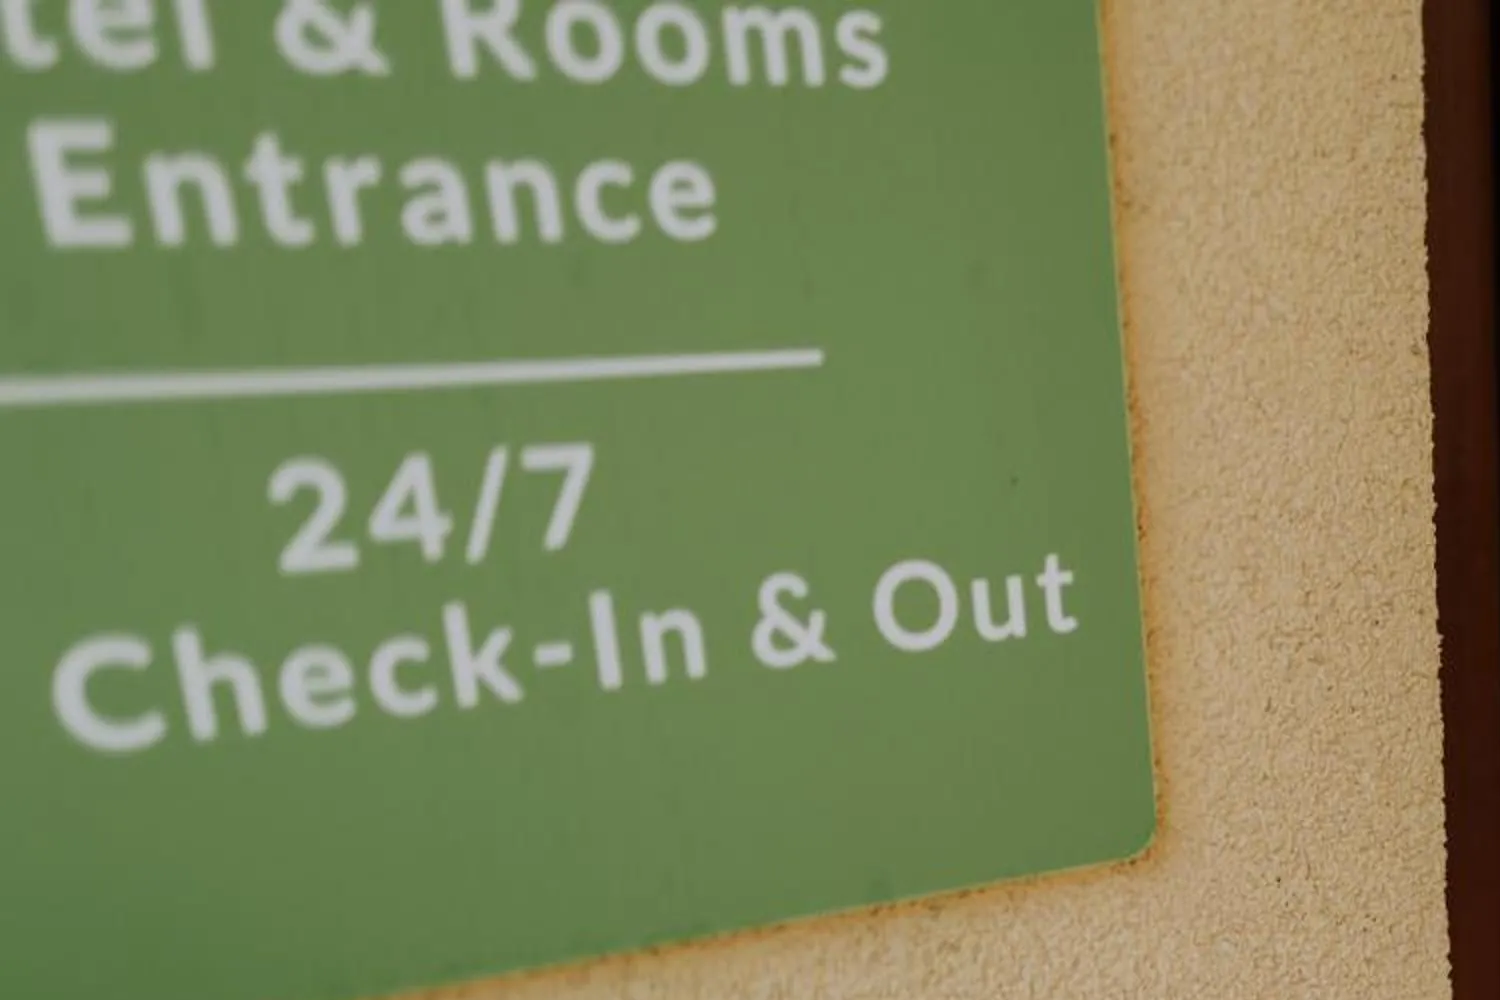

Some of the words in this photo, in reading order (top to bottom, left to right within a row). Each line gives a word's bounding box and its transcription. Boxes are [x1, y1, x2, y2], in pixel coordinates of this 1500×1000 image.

[273, 0, 391, 76] &
[439, 0, 889, 89] Rooms
[26, 117, 718, 249] Entrance
[267, 441, 596, 575] 24/7
[51, 588, 708, 752] Check-In
[750, 571, 838, 670] &
[871, 553, 1080, 653] Out
